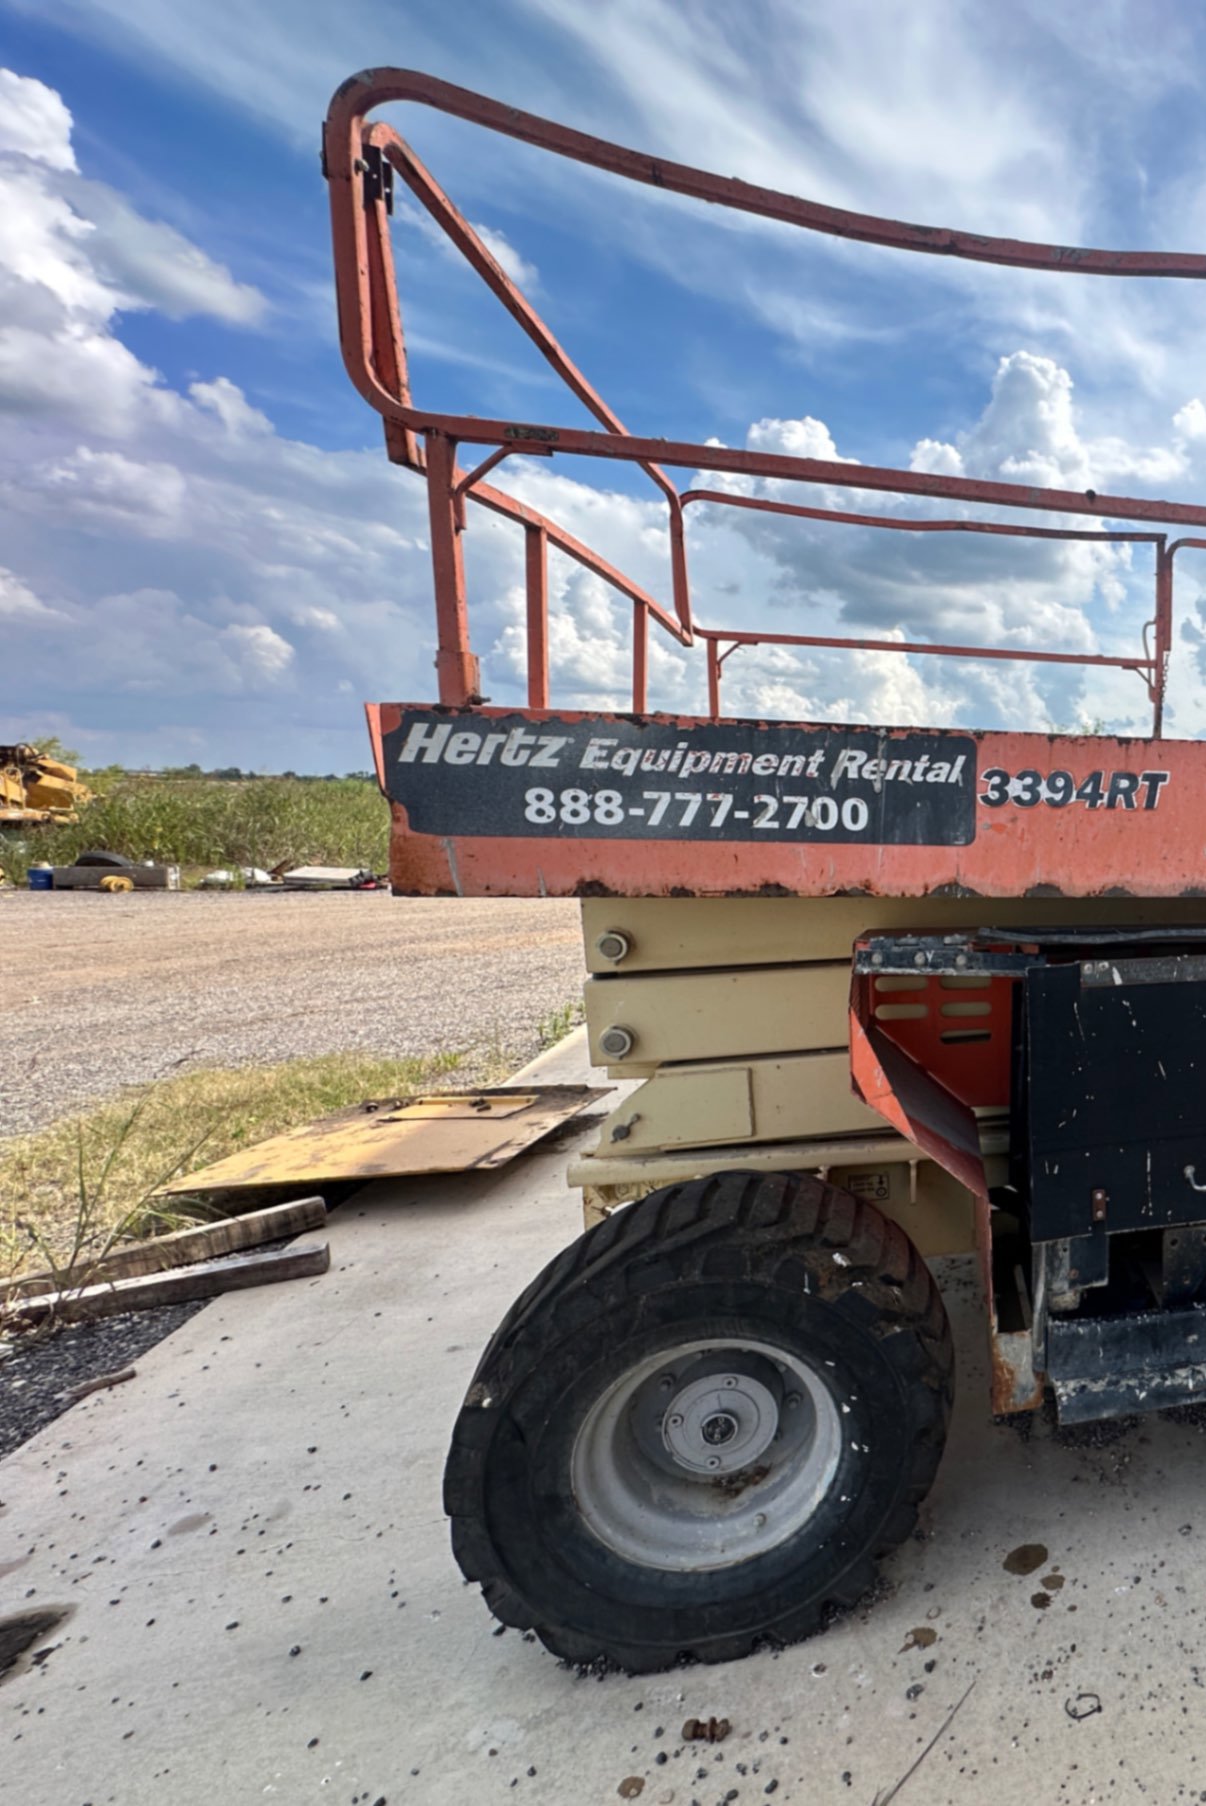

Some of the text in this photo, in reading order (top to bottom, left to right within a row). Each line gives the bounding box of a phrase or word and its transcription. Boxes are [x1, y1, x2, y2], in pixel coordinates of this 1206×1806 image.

[398, 722, 967, 784] Hertz Equipment Rental
[523, 786, 869, 832] 888-777-2700
[978, 766, 1171, 811] 3394RT
